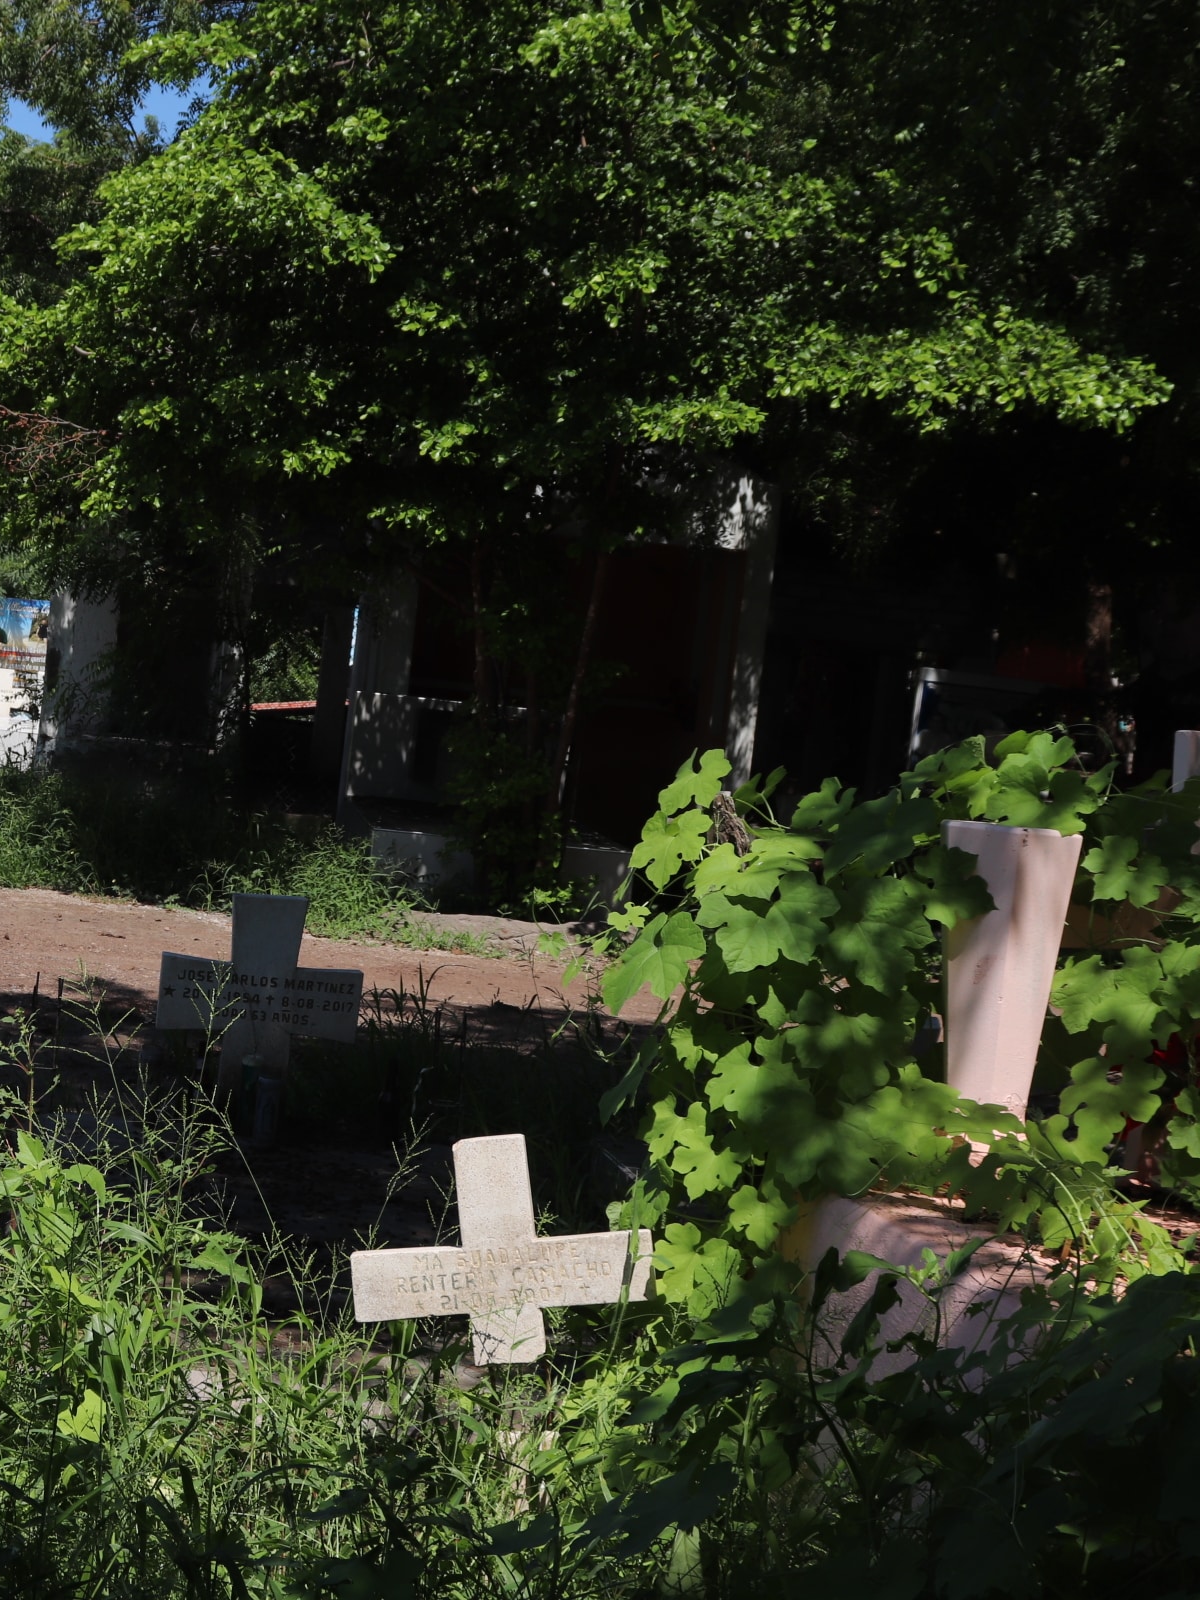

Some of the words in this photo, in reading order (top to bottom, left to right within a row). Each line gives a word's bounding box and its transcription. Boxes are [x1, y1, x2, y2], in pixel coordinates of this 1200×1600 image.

[177, 969, 214, 982] JOSE
[221, 971, 278, 988] ARLOS
[284, 978, 355, 995] MARTINEZ
[396, 1269, 500, 1294] RENTERIA
[511, 1260, 612, 1284] CAMACHO
